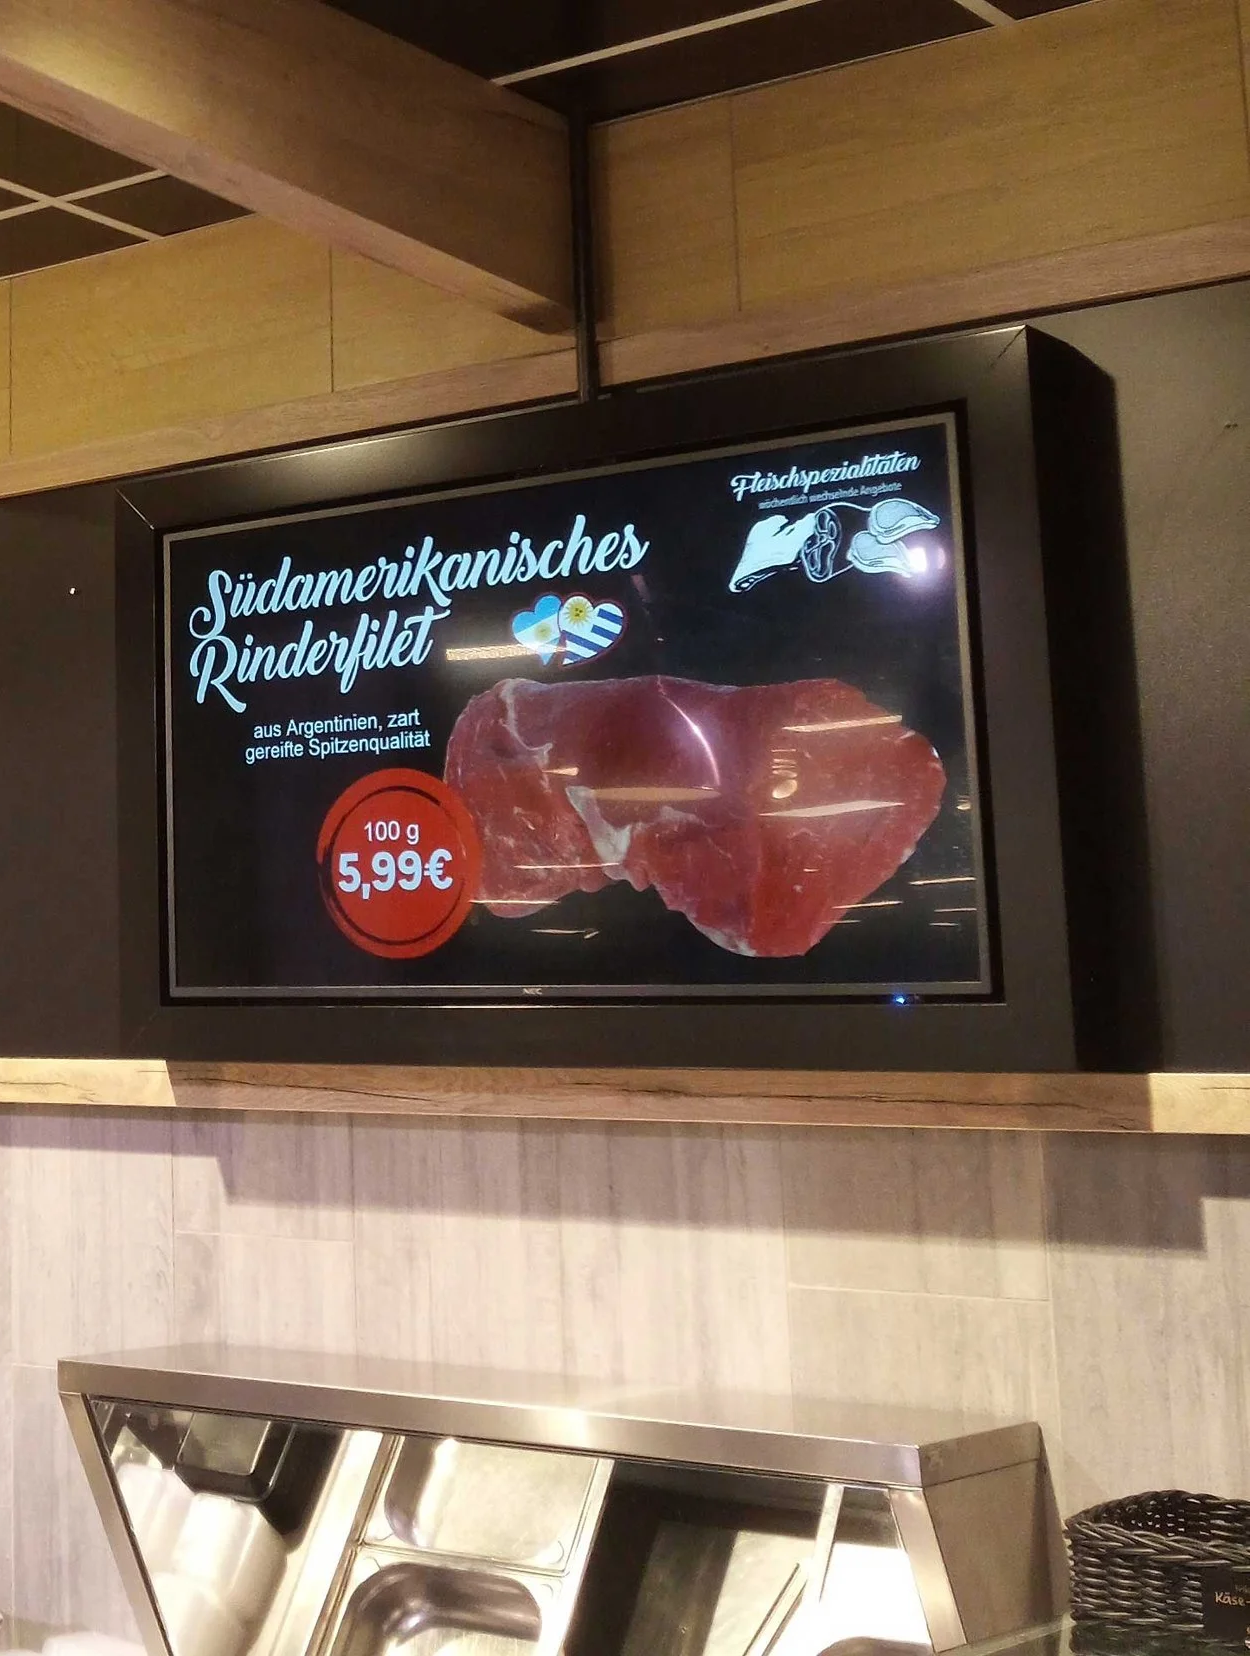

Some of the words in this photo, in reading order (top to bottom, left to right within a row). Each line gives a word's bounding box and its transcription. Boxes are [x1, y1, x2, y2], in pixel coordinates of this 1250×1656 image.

[189, 514, 651, 639] Südamerikanisches
[189, 606, 451, 713] Rinderfilet
[253, 724, 282, 739] aus
[286, 713, 384, 739] Argentinien,
[387, 708, 421, 728] zart
[245, 741, 304, 765] gereifte
[308, 729, 432, 760] Spitzenqualität
[363, 820, 401, 842] 100
[406, 823, 420, 845] g
[337, 848, 454, 900] 5,99€
